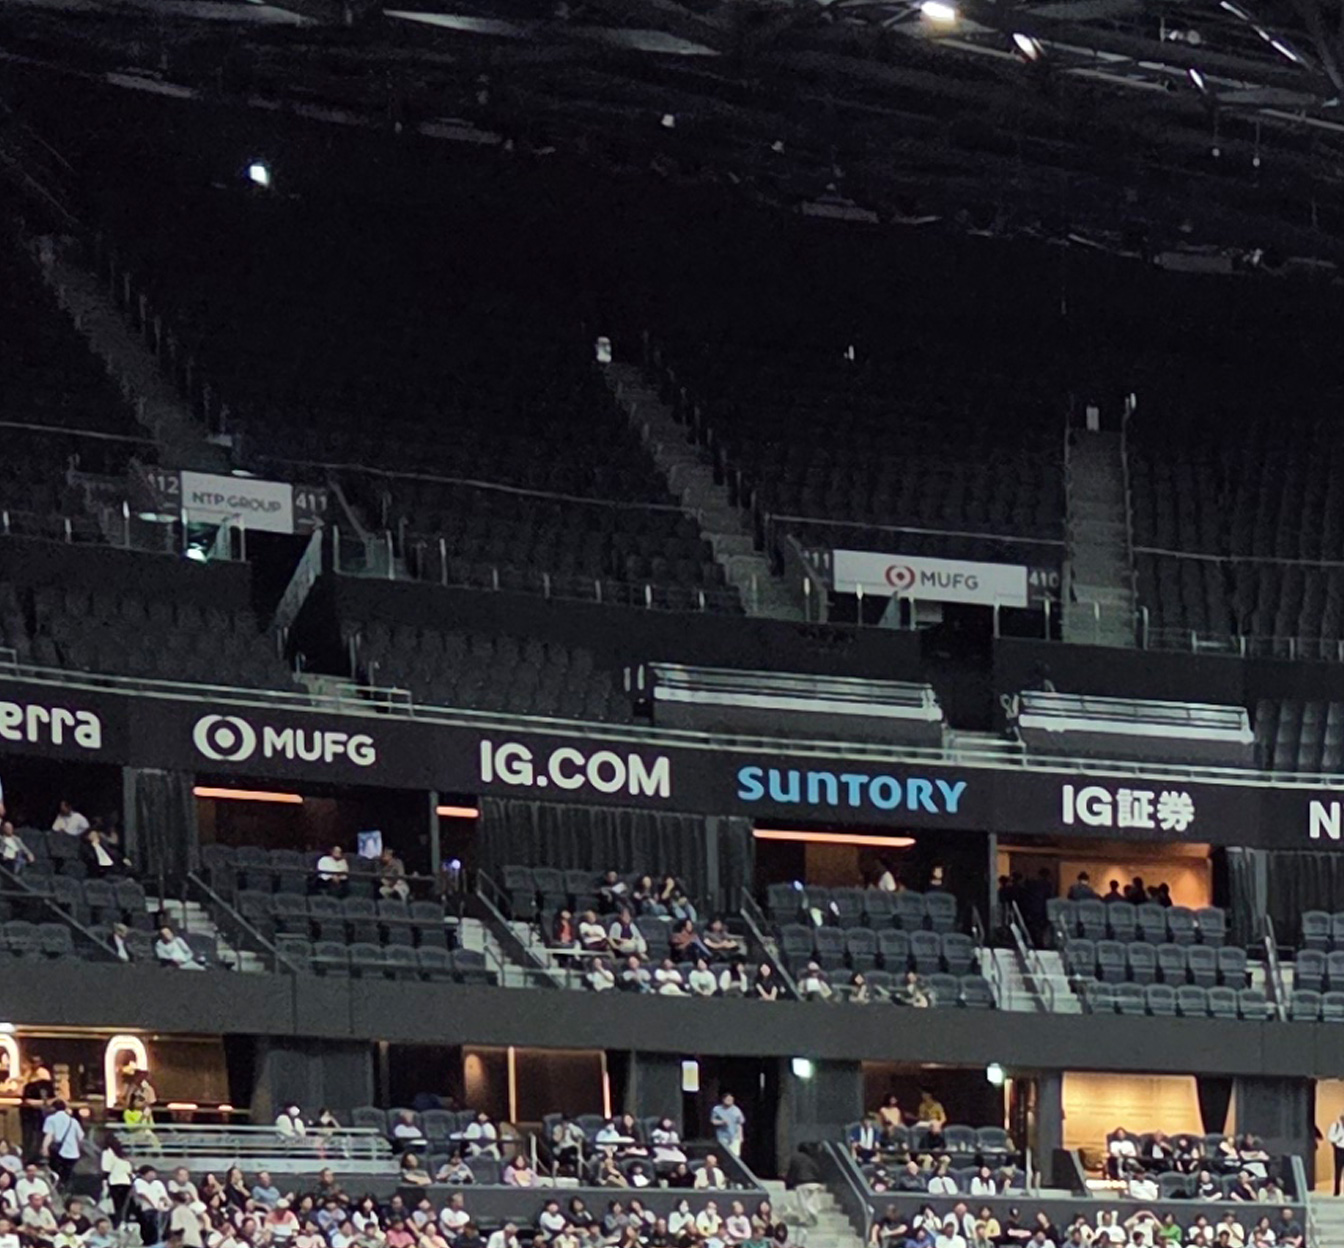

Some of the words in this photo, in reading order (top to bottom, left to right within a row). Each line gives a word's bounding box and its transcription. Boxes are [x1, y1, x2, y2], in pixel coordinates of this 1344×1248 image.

[191, 491, 224, 506] NTP
[227, 495, 282, 513] GROUP
[920, 570, 979, 591] MUFG
[0, 701, 102, 749] erra
[263, 726, 376, 766] MUFG
[480, 740, 671, 798] IG.COM
[738, 766, 967, 815] SUNTORY
[1062, 785, 1195, 832] IG証券
